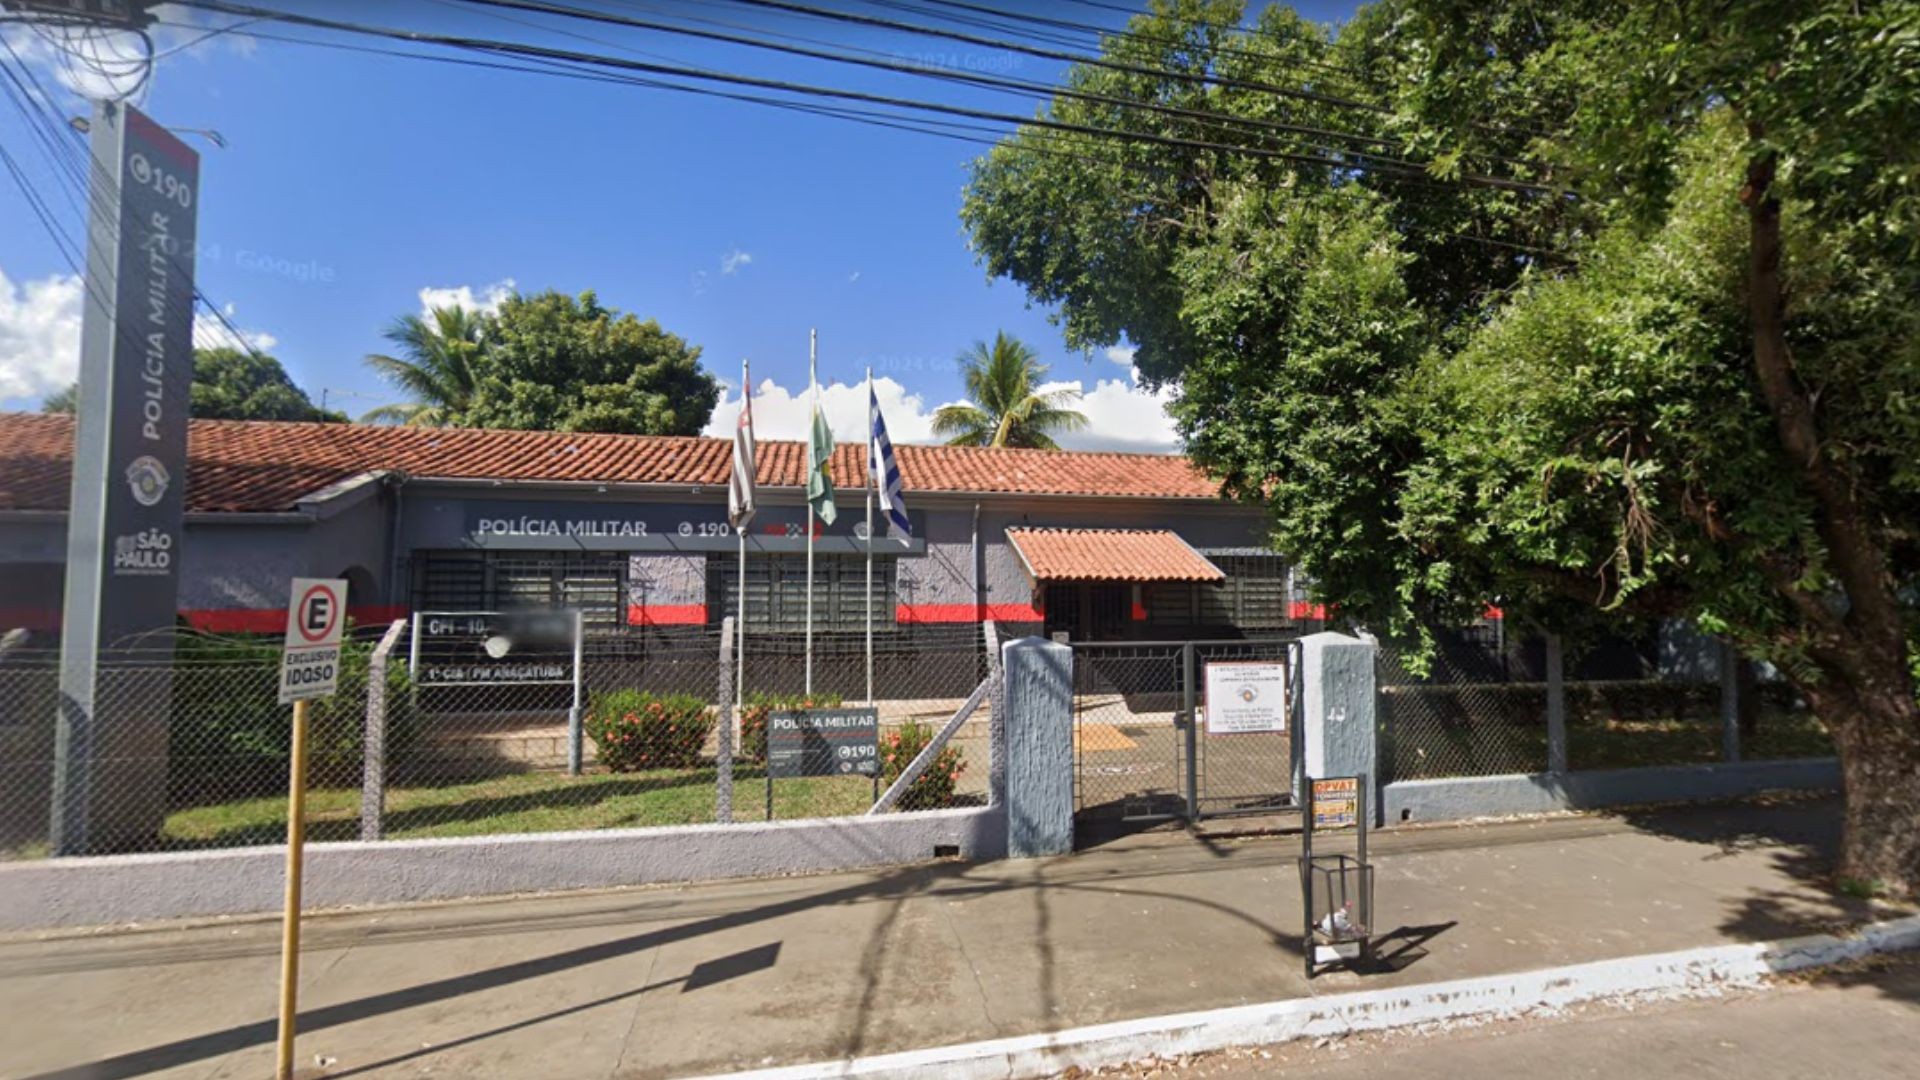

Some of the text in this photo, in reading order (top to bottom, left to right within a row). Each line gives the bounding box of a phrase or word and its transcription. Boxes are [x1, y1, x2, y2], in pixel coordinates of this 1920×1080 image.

[153, 167, 190, 208] 190
[141, 211, 169, 441] POLÍCIA MILITAR
[478, 516, 648, 537] POLÍCIA MILITAR
[698, 523, 729, 537] 190
[137, 528, 171, 549] SÃO
[114, 551, 170, 568] PAULO
[308, 598, 329, 629] E
[286, 650, 337, 665] EXCLUSIVO
[285, 665, 334, 686] IDOSO
[825, 716, 874, 728] MILITAR
[850, 745, 876, 758] 190
